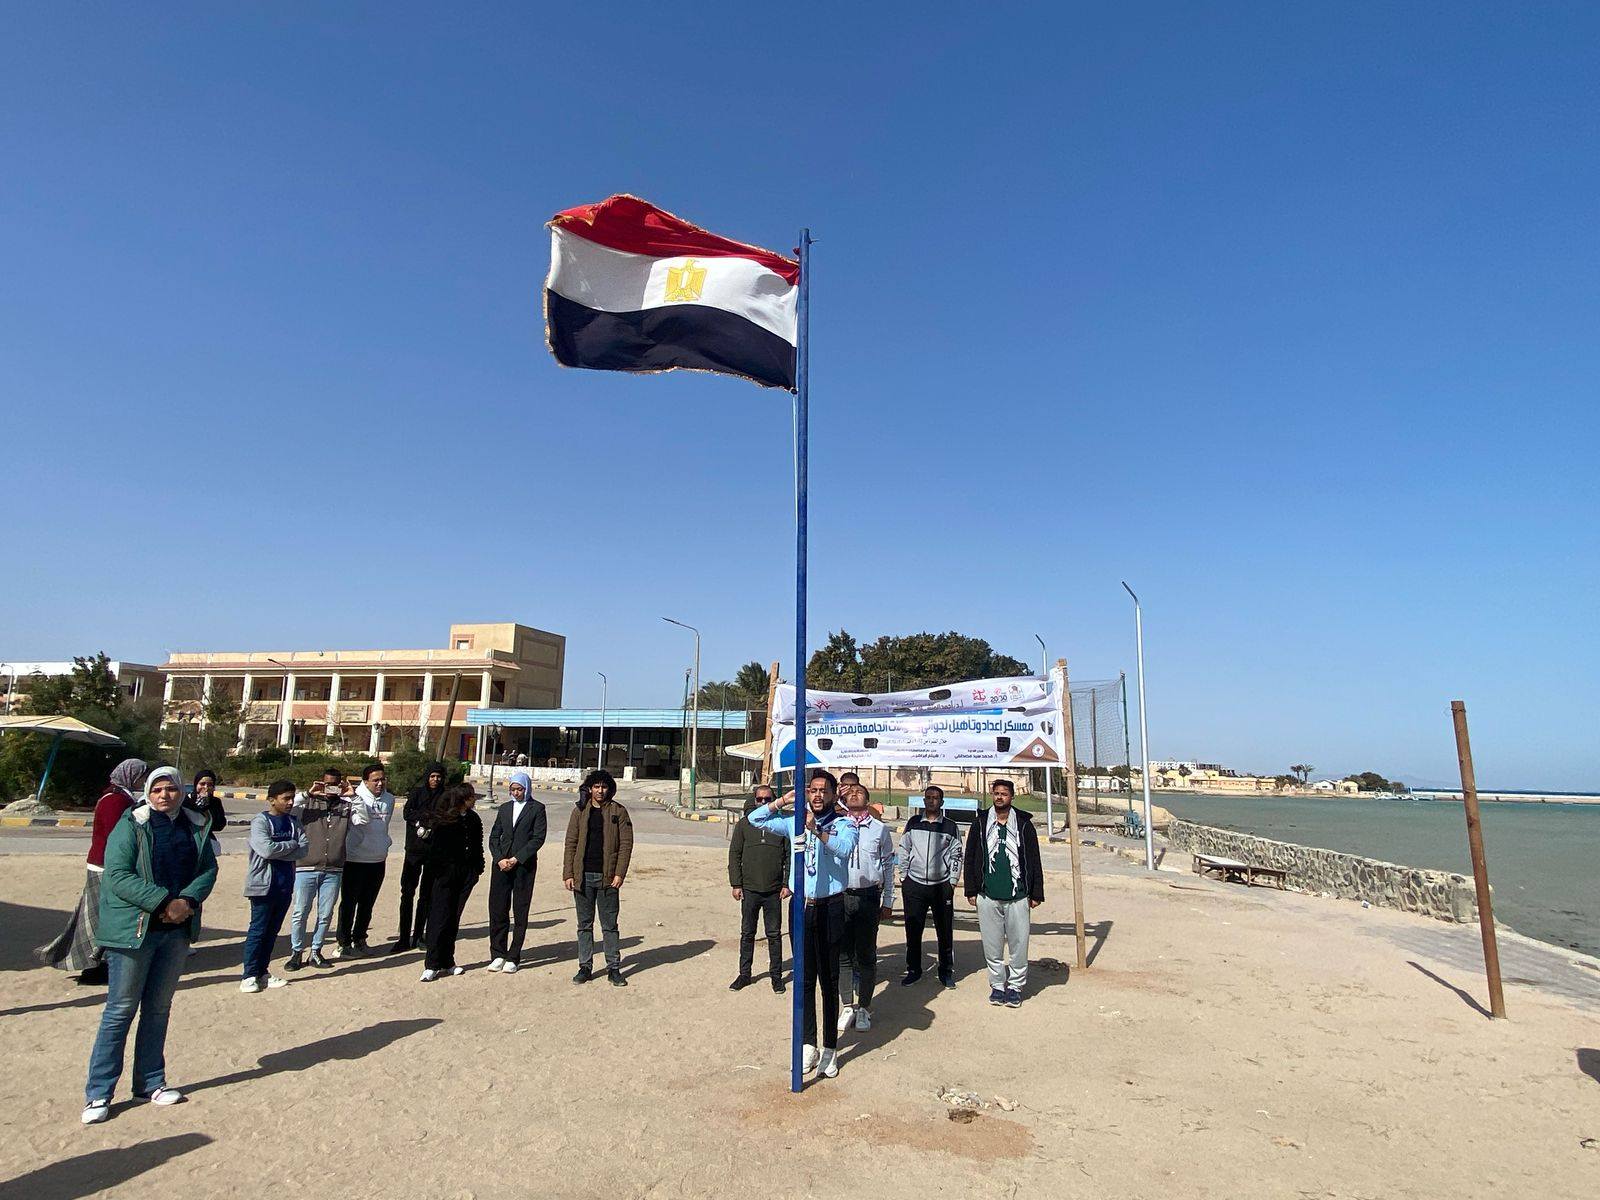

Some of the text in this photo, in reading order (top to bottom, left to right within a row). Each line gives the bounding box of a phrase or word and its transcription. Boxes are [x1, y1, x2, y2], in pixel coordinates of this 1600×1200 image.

[830, 724, 857, 737] بمدينة
[857, 722, 888, 736] الجامعة
[949, 716, 982, 734] وتأهيل
[982, 719, 1003, 735] إعداد
[1003, 719, 1034, 734] معسكر
